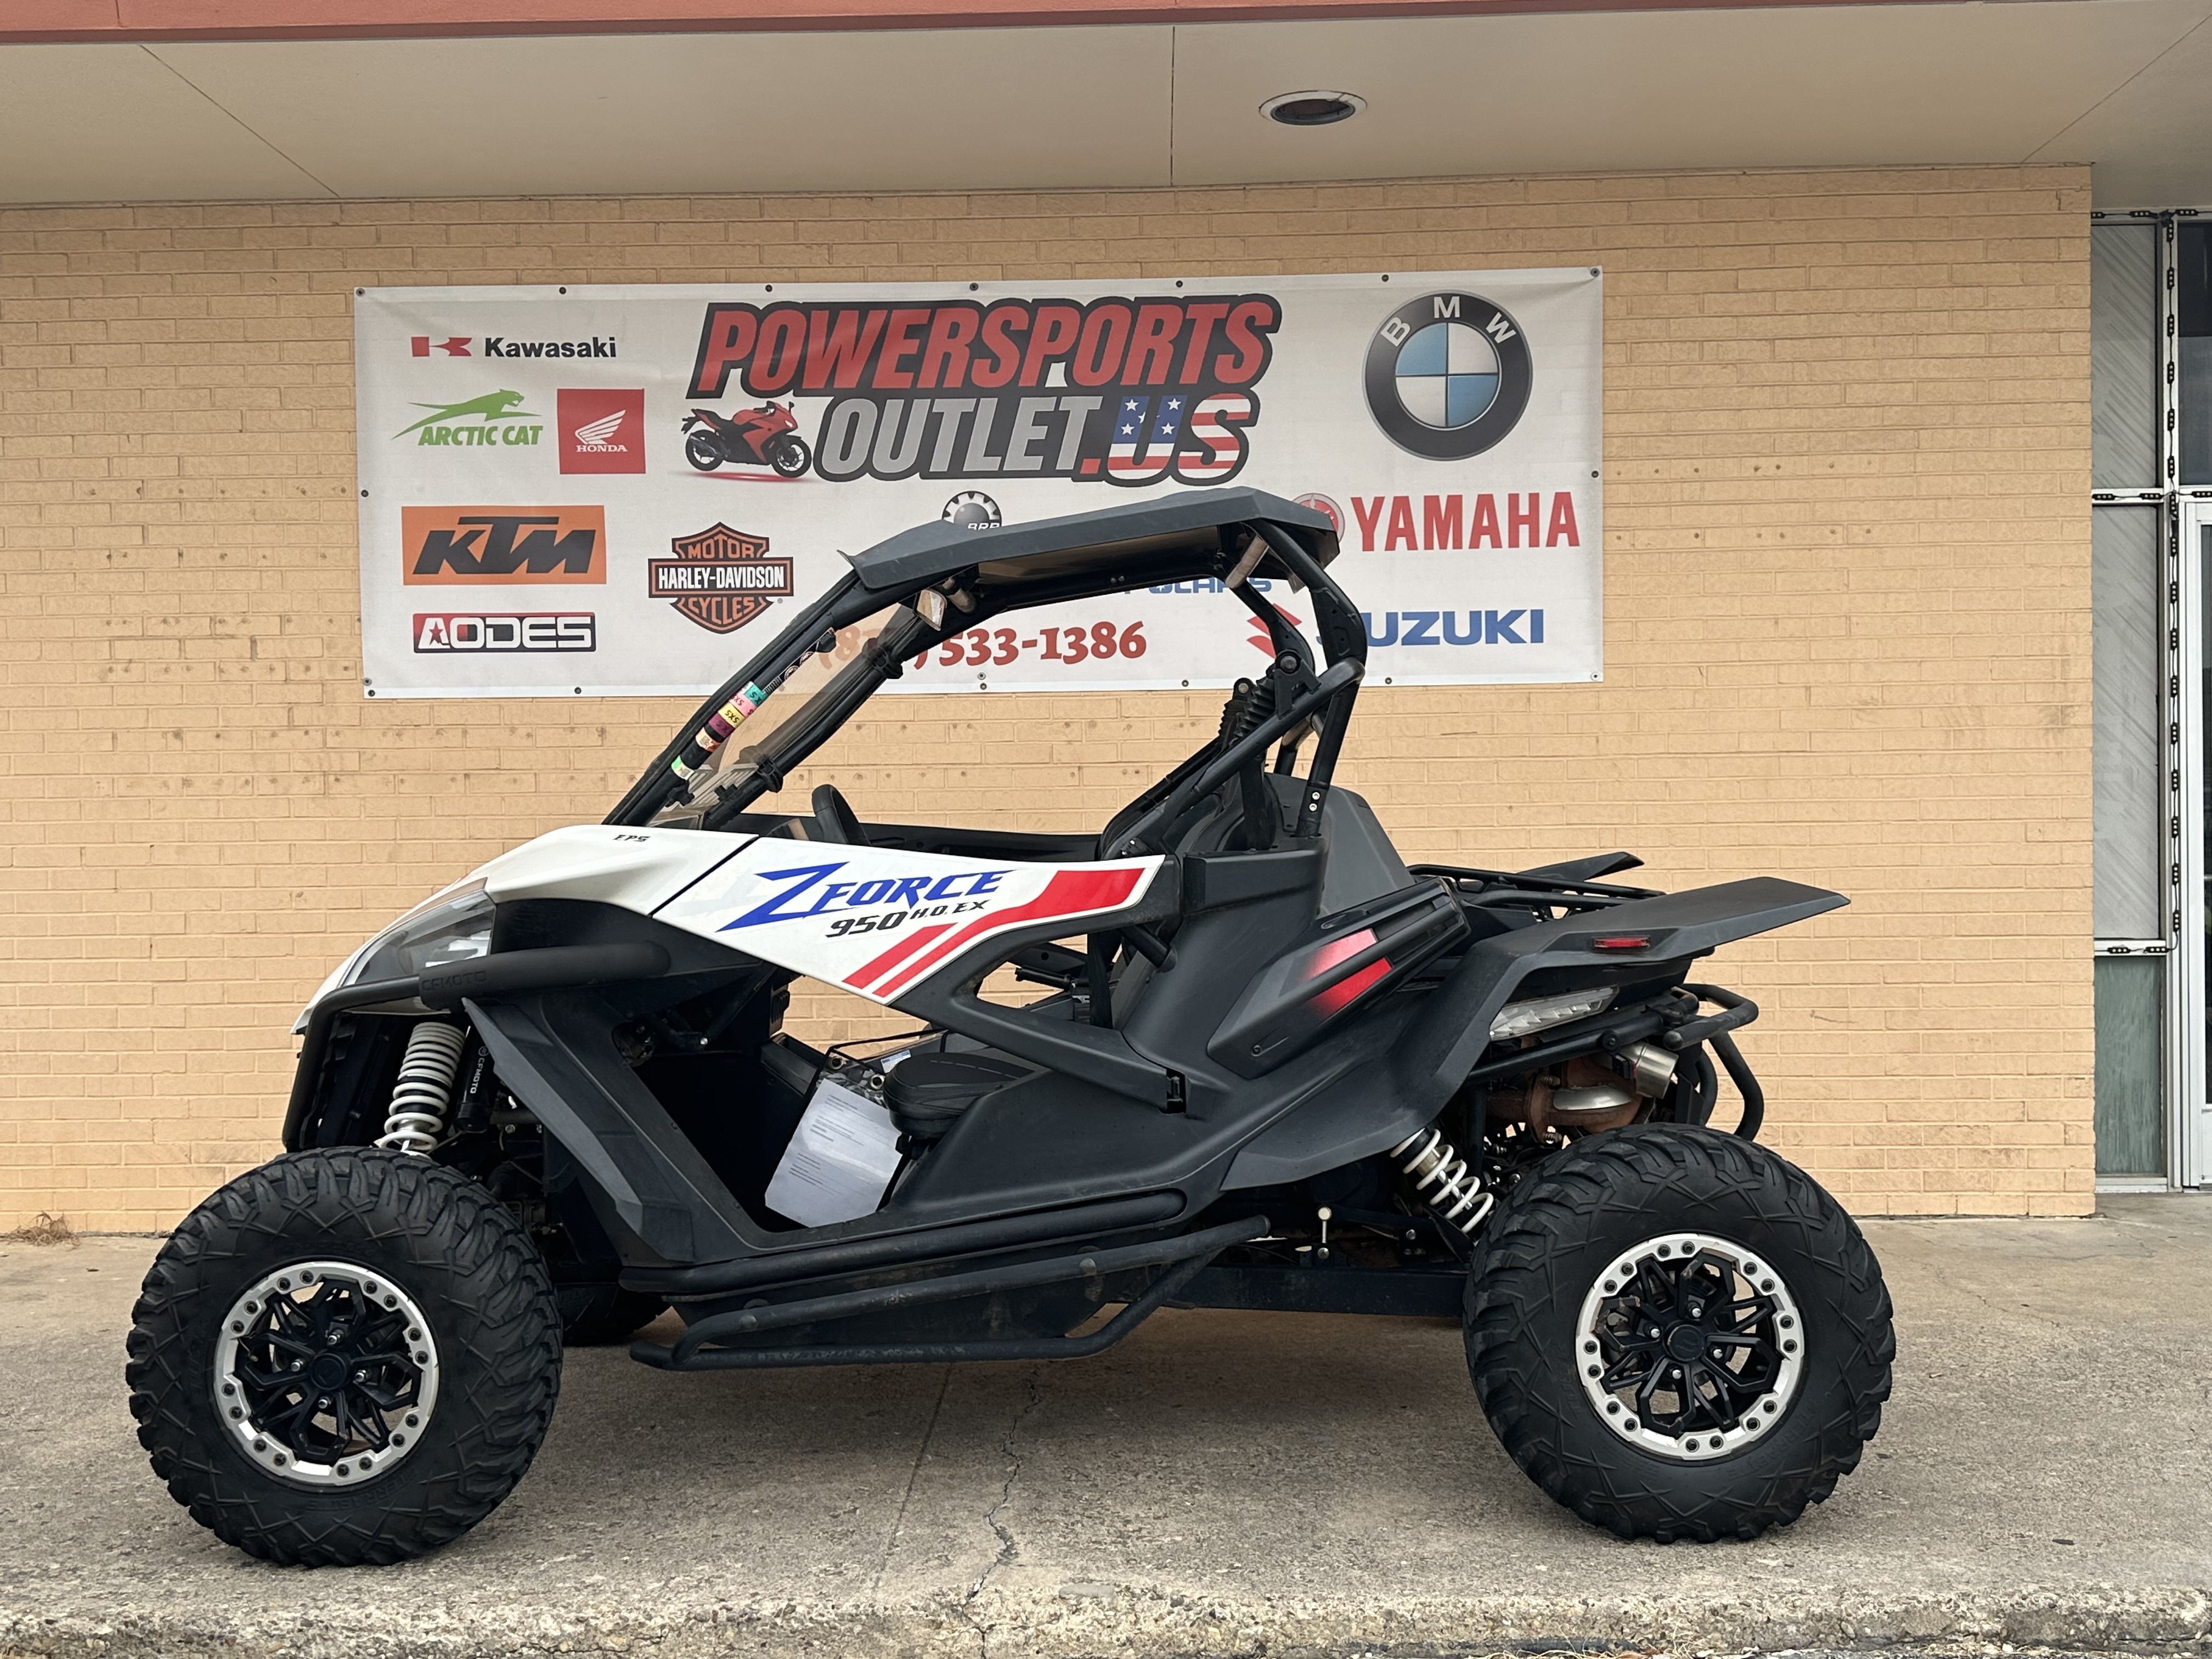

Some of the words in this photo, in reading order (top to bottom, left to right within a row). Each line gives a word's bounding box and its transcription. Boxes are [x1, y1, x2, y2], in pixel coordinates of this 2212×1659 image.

[1380, 295, 1517, 347] BMW
[485, 336, 617, 358] Kawasaki
[695, 302, 1269, 393] POWERSPORTS
[417, 426, 498, 446] ARCTIC
[501, 425, 544, 445] CAT
[820, 391, 1252, 481] OUTLET.US
[1350, 492, 1581, 552] YAMAHA
[413, 516, 596, 575] KTM
[687, 533, 754, 559] MOTOR
[658, 566, 785, 589] HARLEY-DAVIDSON
[687, 596, 755, 625] CYCLES
[417, 616, 592, 650] AODES
[1316, 608, 1544, 647] UZUKI
[939, 620, 1147, 667] 533-1386
[724, 709, 740, 723] SXS
[612, 834, 651, 842] EPS
[825, 911, 909, 938] 950
[421, 970, 487, 991] CFMOTO
[470, 1057, 485, 1094] CFMOTO
